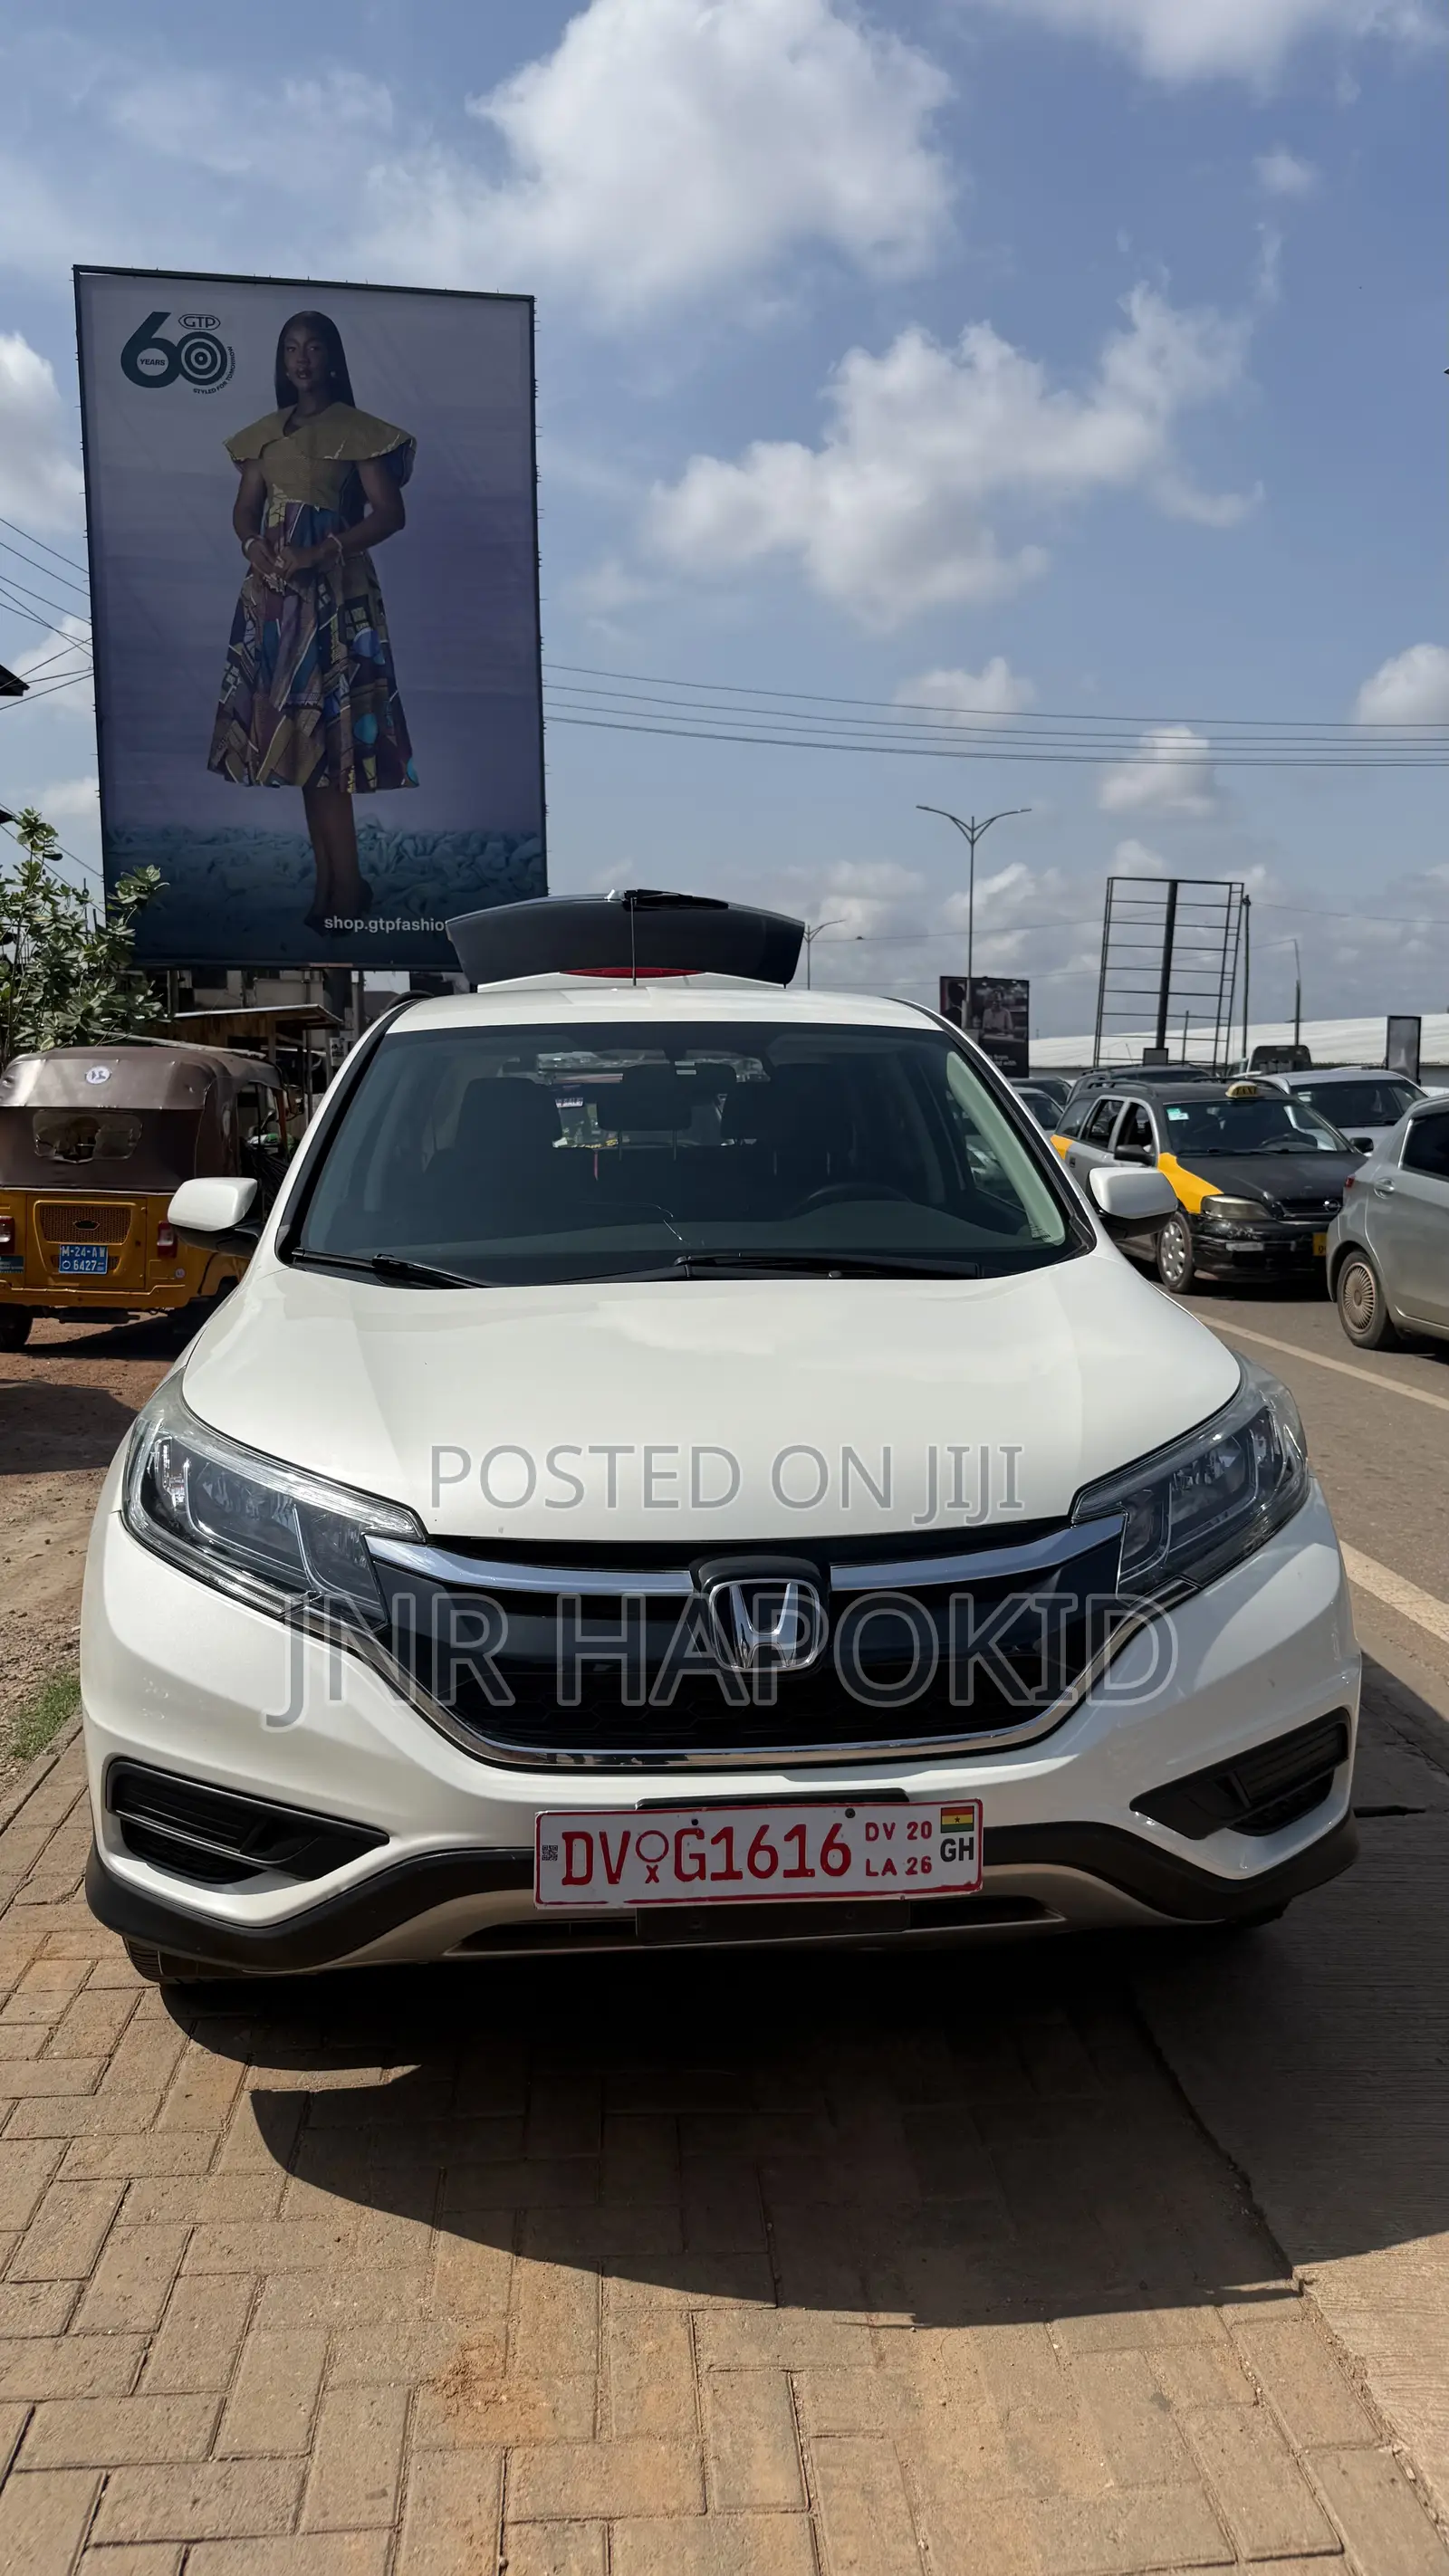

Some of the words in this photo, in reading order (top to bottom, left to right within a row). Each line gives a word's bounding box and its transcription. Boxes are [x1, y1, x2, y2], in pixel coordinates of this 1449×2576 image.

[182, 315, 217, 328] GTP
[139, 358, 166, 367] YEARS
[216, 380, 228, 391] FOR
[226, 346, 235, 381] TOMORROW
[324, 915, 446, 934] shop.gtpfashio
[73, 1259, 97, 1271] 6427
[865, 1822, 897, 1842] DV
[907, 1820, 933, 1841] 20
[939, 1836, 974, 1863] GH
[865, 1857, 897, 1877] LA
[905, 1856, 933, 1876] 26
